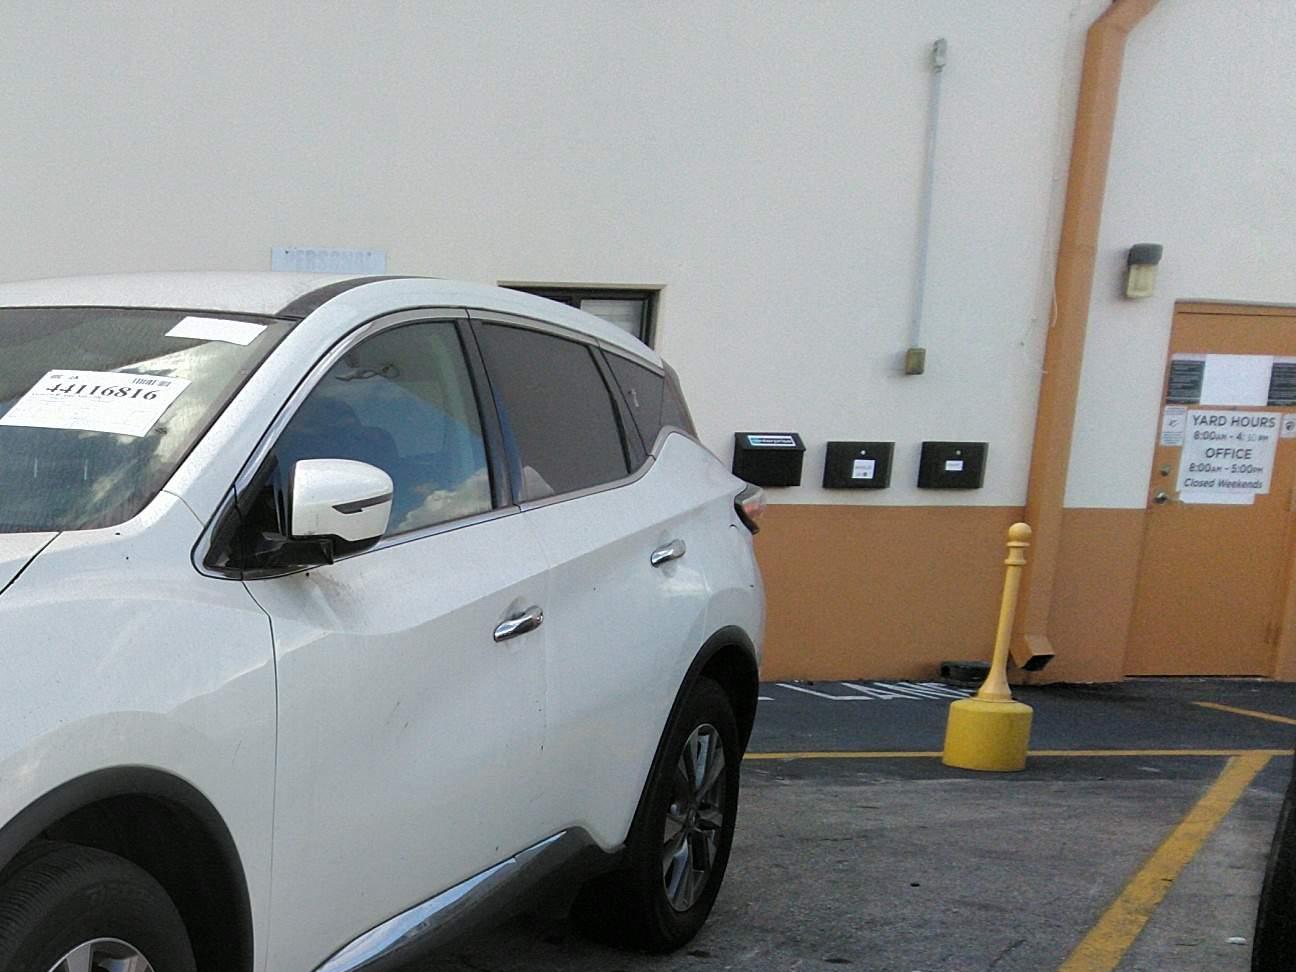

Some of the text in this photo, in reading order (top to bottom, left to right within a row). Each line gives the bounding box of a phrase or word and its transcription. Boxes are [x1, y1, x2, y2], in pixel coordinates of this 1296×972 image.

[46, 383, 160, 401] 44116816
[1192, 415, 1276, 428] YARD HOURS
[1205, 447, 1253, 460] OFFICE
[1183, 478, 1263, 489] Closed Weekends
